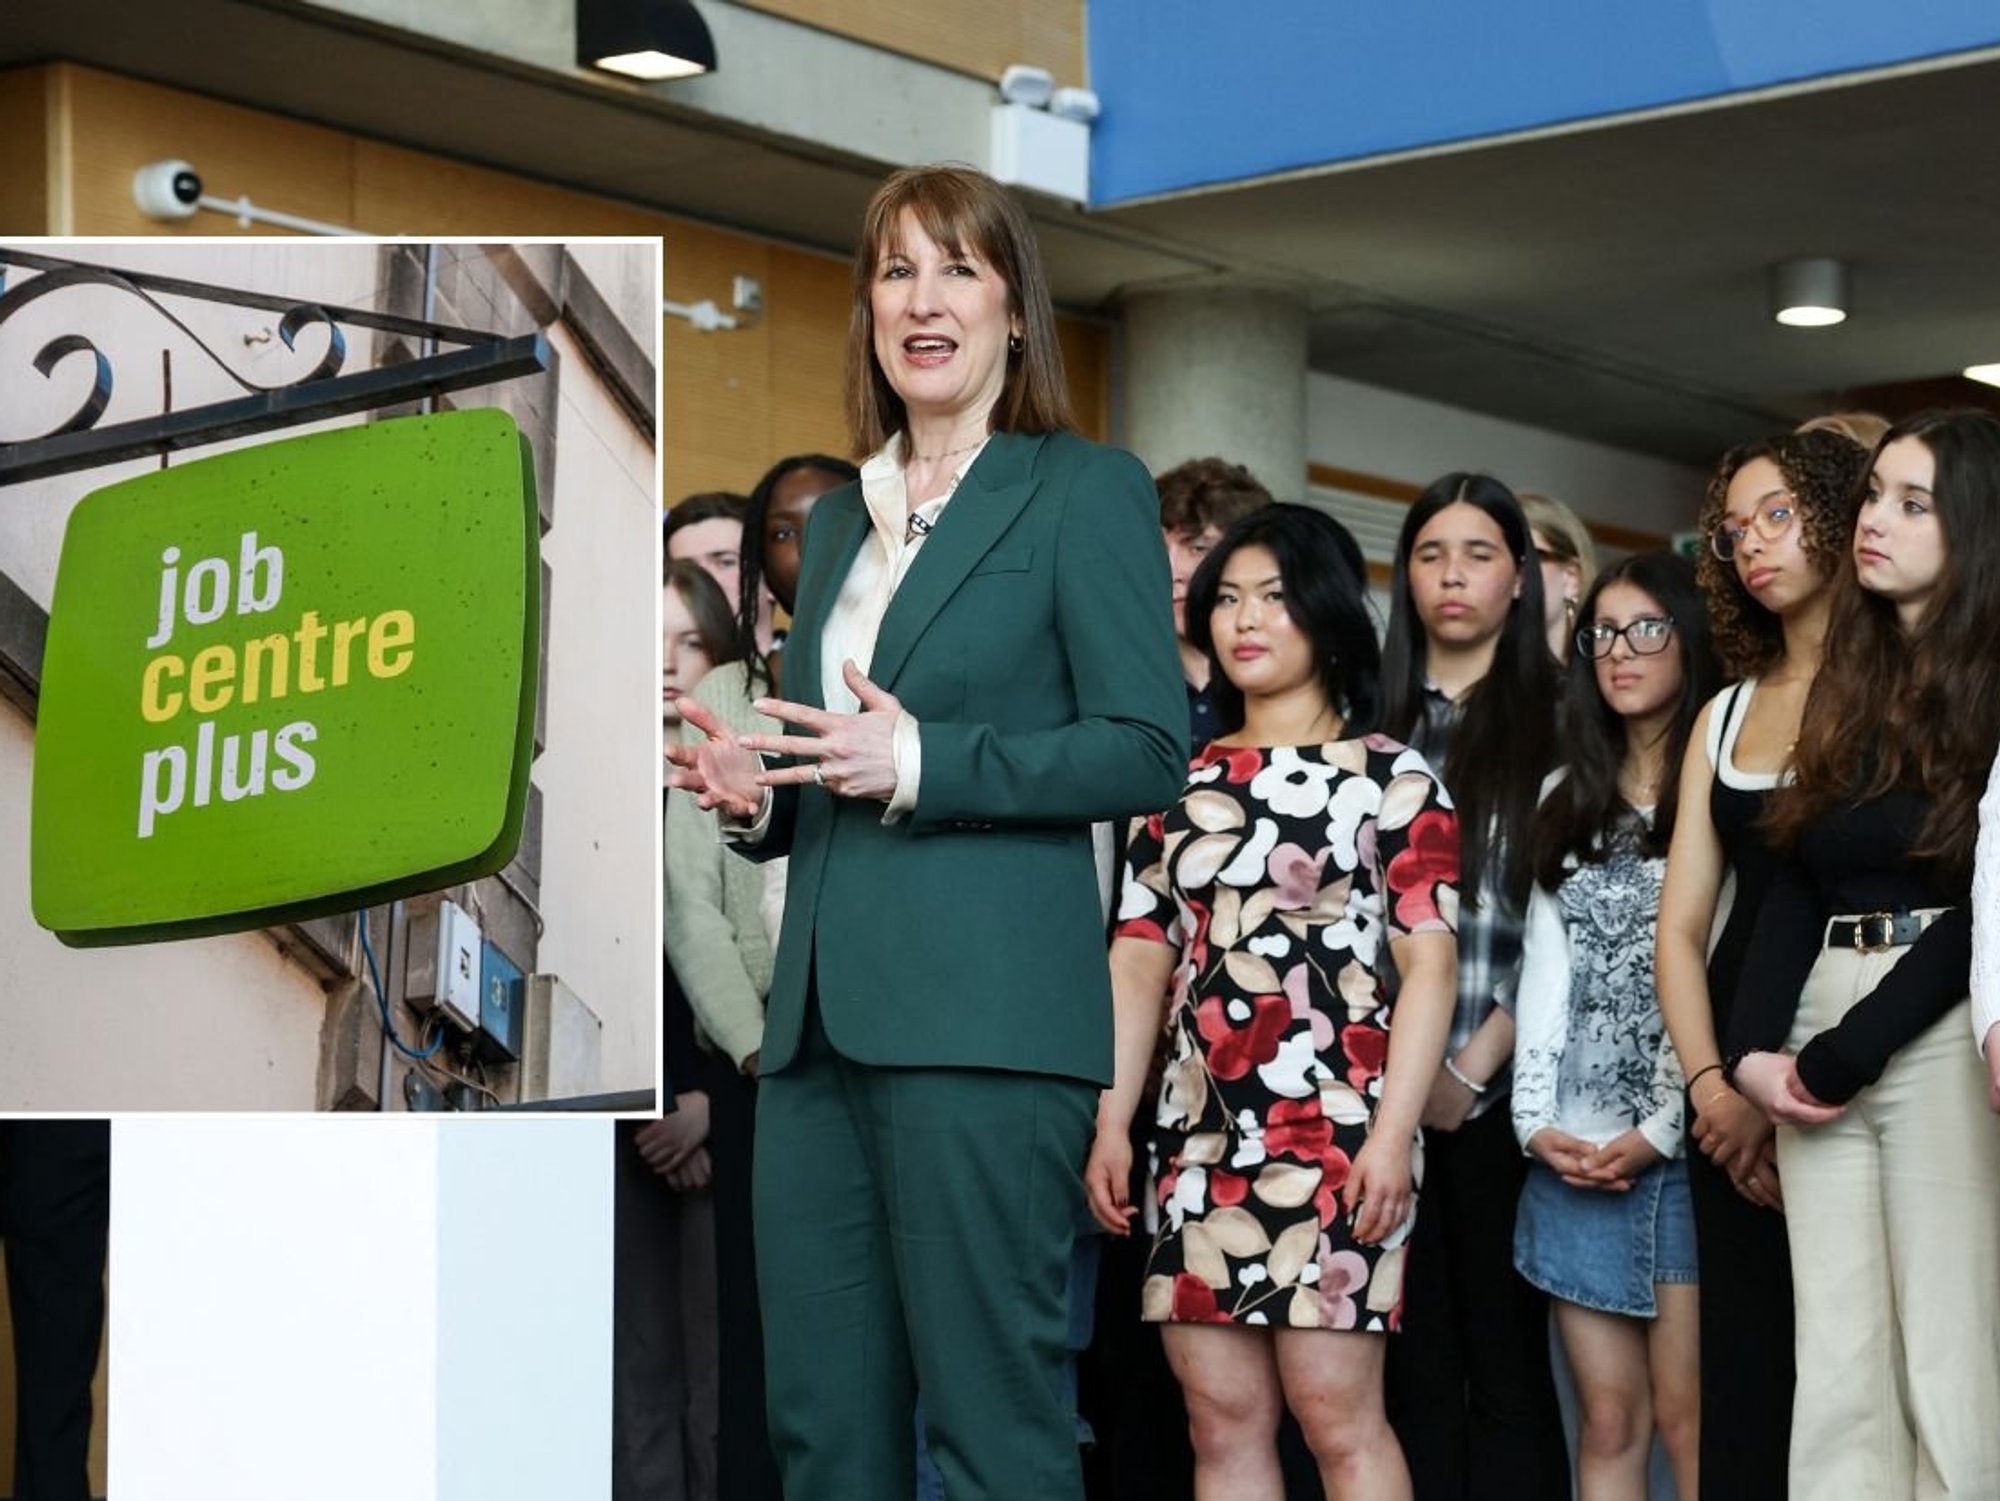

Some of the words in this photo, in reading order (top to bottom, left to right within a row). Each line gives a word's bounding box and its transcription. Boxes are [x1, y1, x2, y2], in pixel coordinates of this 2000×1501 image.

[146, 531, 284, 649] job
[140, 609, 416, 723] centre
[138, 721, 318, 838] plus
